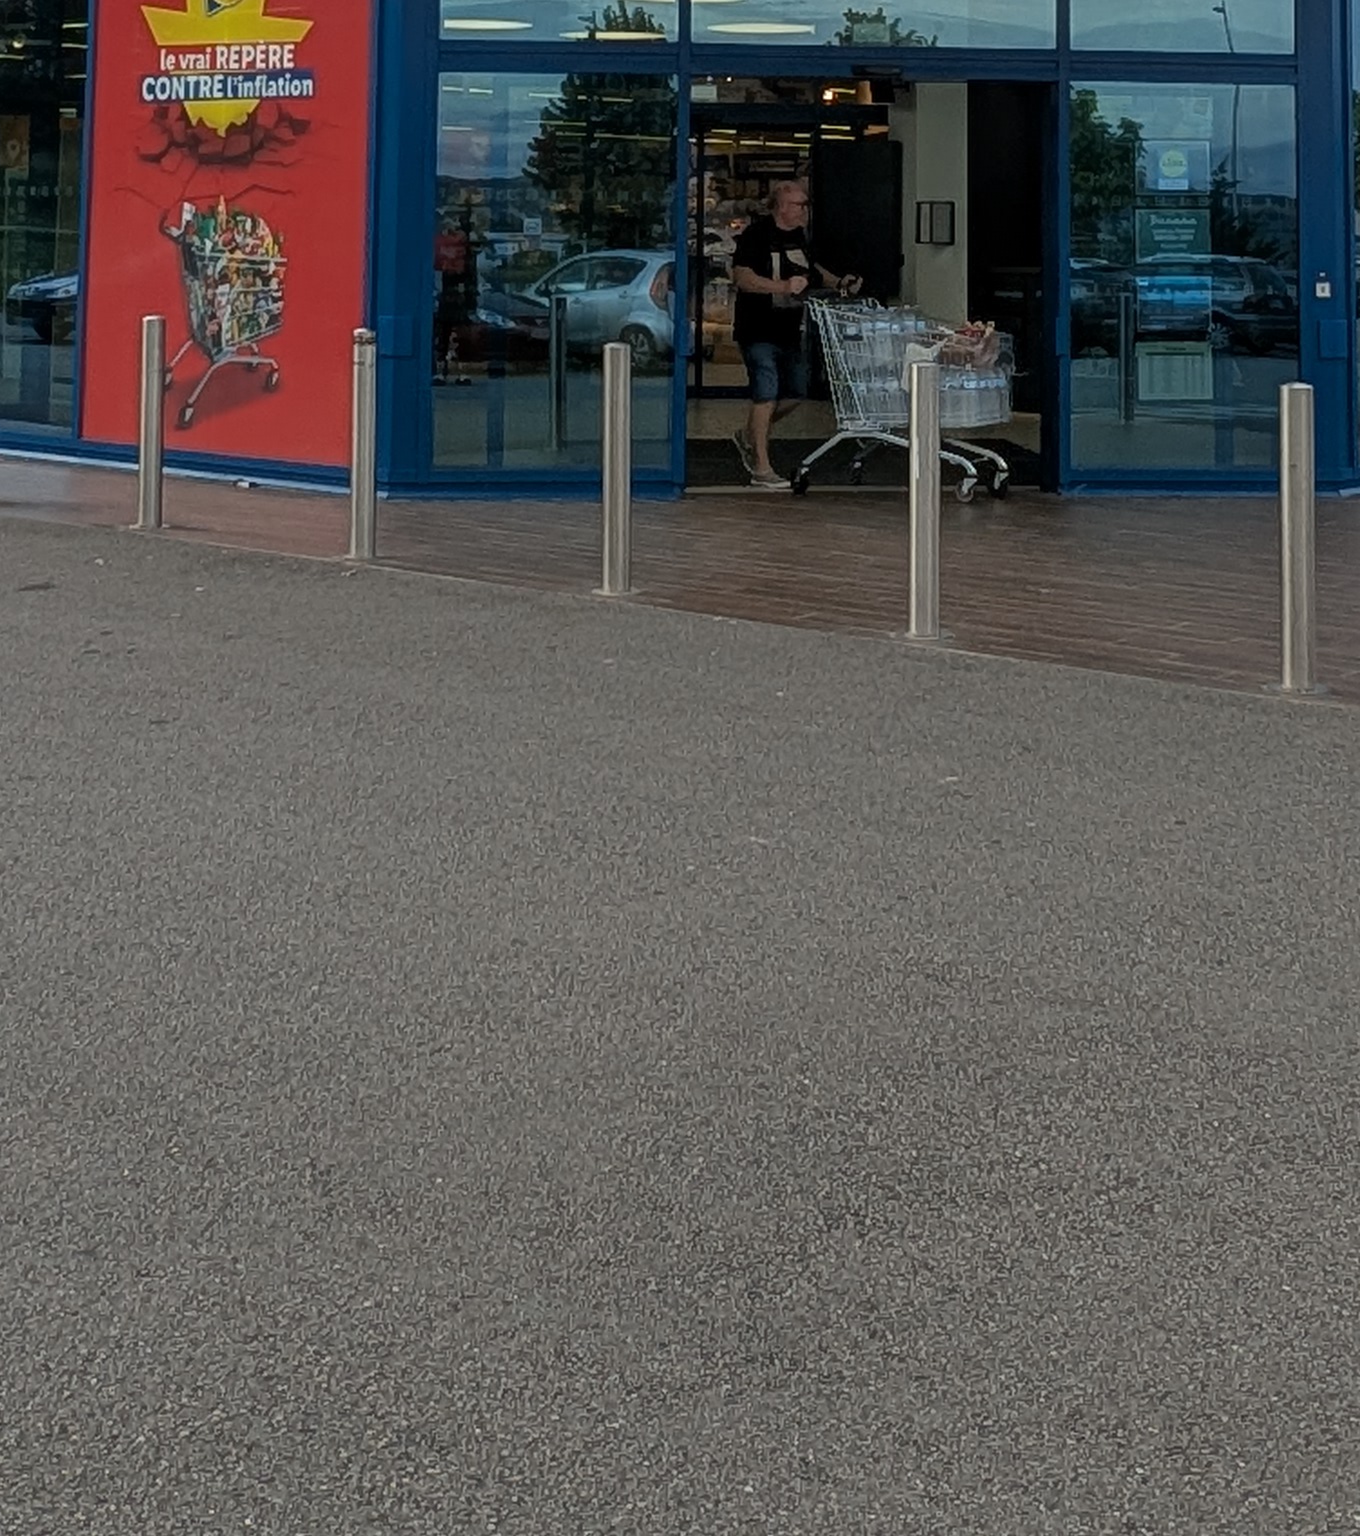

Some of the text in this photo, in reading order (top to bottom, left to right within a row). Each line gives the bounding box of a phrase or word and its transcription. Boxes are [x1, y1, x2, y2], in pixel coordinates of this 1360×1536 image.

[160, 40, 295, 71] le vrai REPÈRE
[142, 72, 313, 101] CONTRE l'inflation
